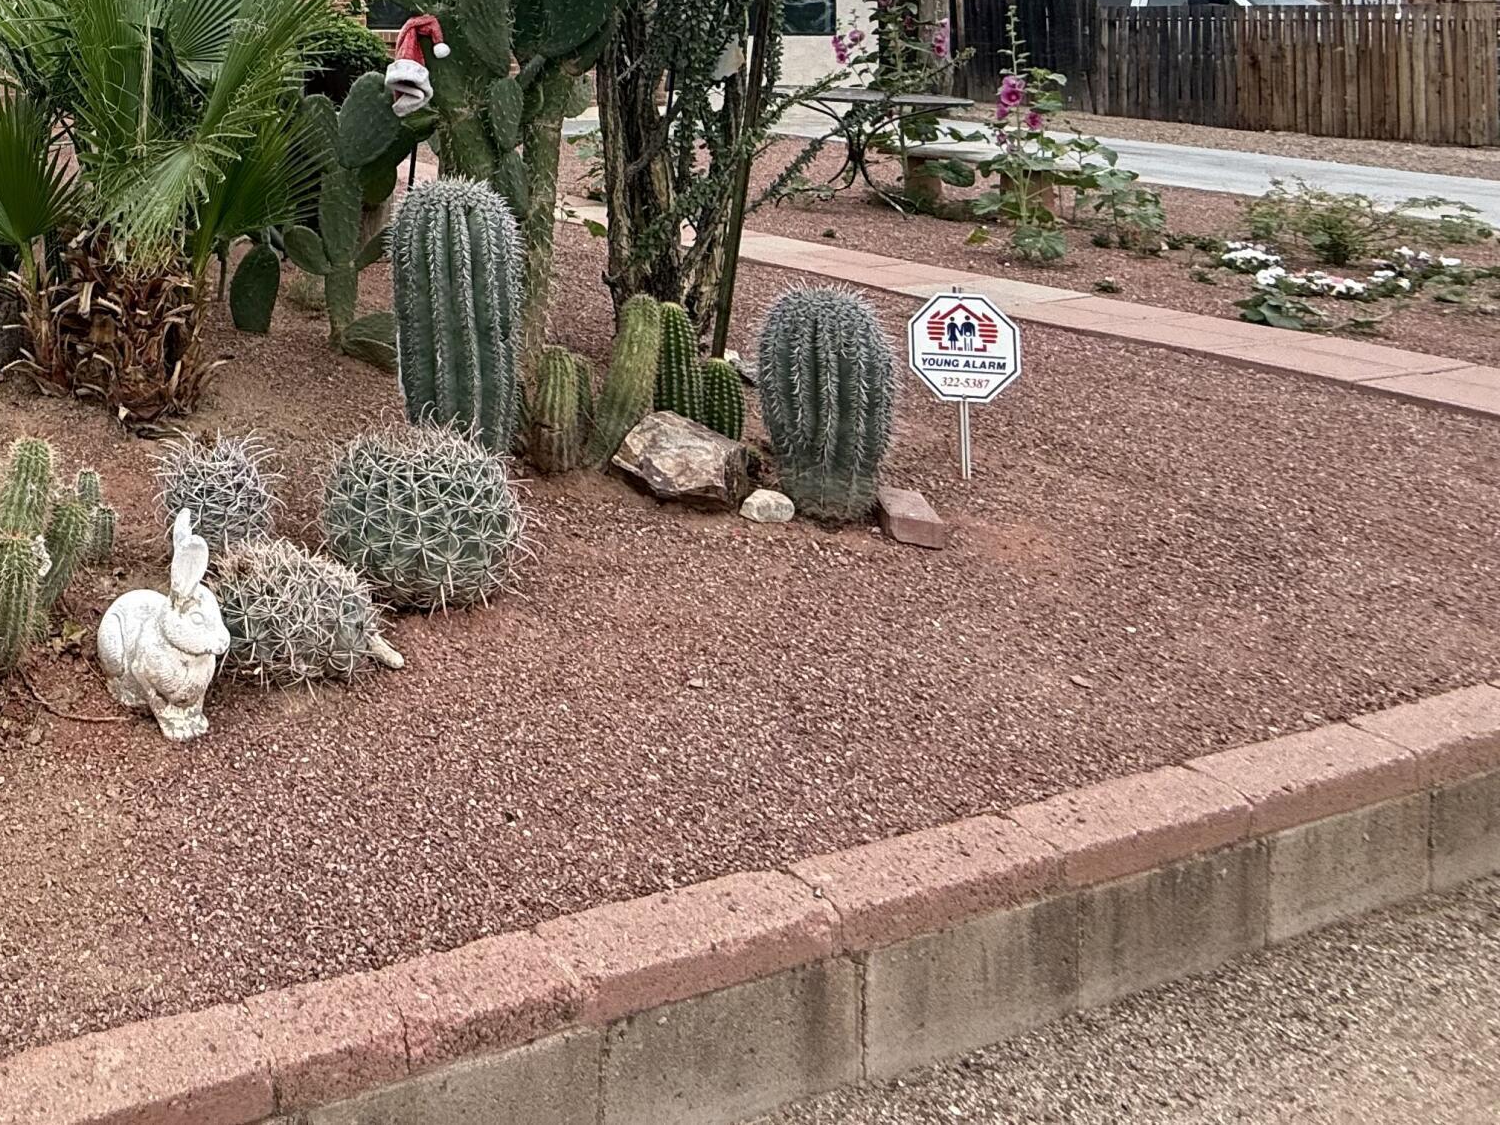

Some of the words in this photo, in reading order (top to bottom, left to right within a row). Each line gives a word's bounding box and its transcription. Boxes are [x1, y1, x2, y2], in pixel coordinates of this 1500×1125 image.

[921, 357, 960, 368] YOUNG
[963, 360, 1006, 370] ALARM
[940, 376, 990, 389] 322-5387
